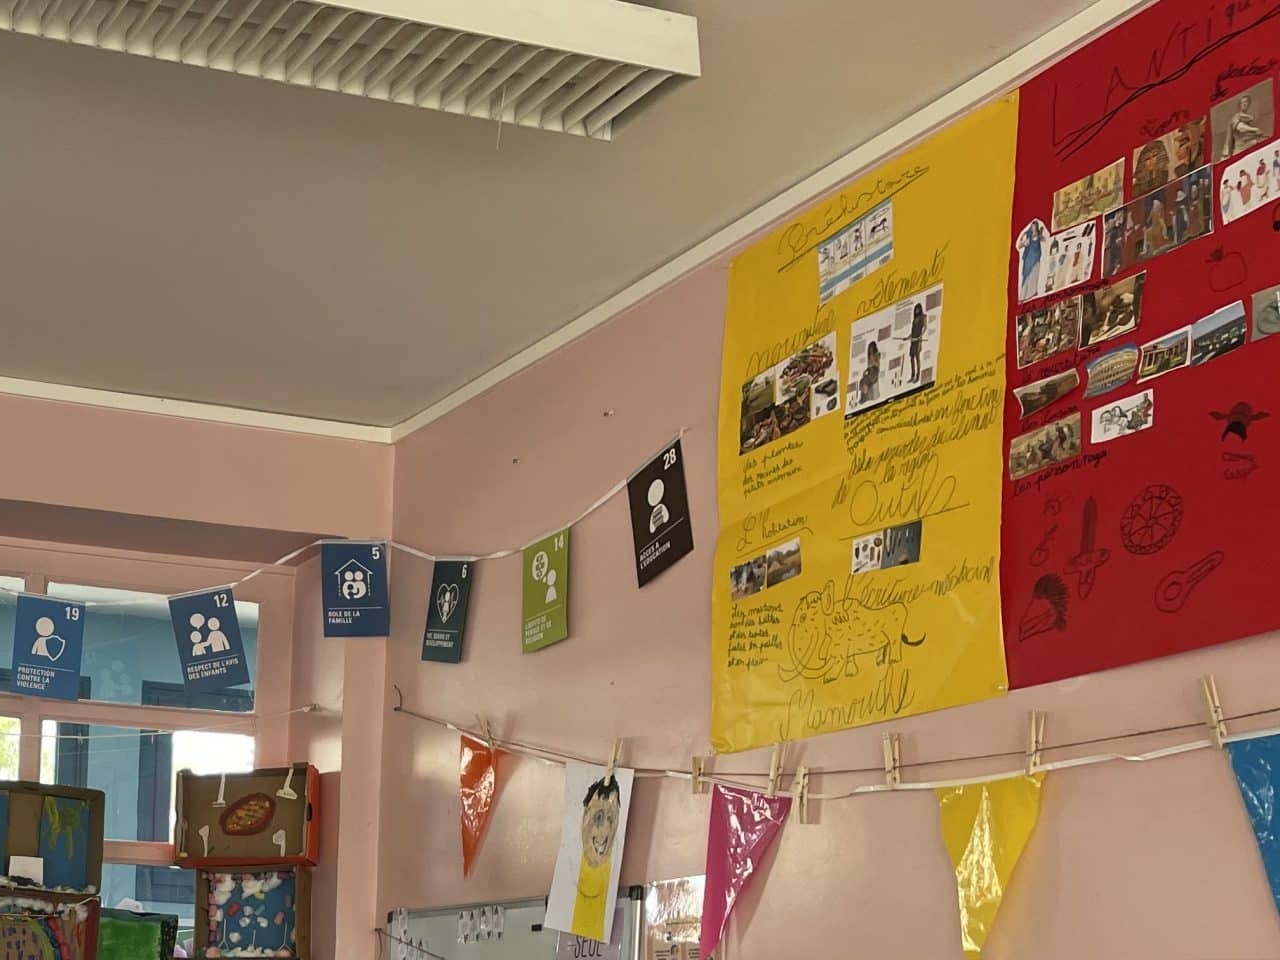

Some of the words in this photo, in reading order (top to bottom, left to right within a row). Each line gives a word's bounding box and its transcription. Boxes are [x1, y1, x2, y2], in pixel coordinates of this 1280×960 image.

[663, 448, 677, 470] 28
[554, 534, 564, 552] 14
[371, 547, 380, 560] 5
[461, 564, 468, 578] 6
[213, 593, 229, 608] 12
[64, 606, 80, 621] 19
[328, 617, 353, 625] FAMILLE
[17, 666, 55, 678] PROTECTION
[187, 663, 212, 674] RESPECT
[220, 658, 239, 669] L'AVIS
[17, 674, 40, 683] CONTRE
[41, 676, 50, 684] LA
[188, 672, 200, 681] DES
[200, 668, 228, 679] ENFANTS
[16, 679, 46, 690] VIOLENCE
